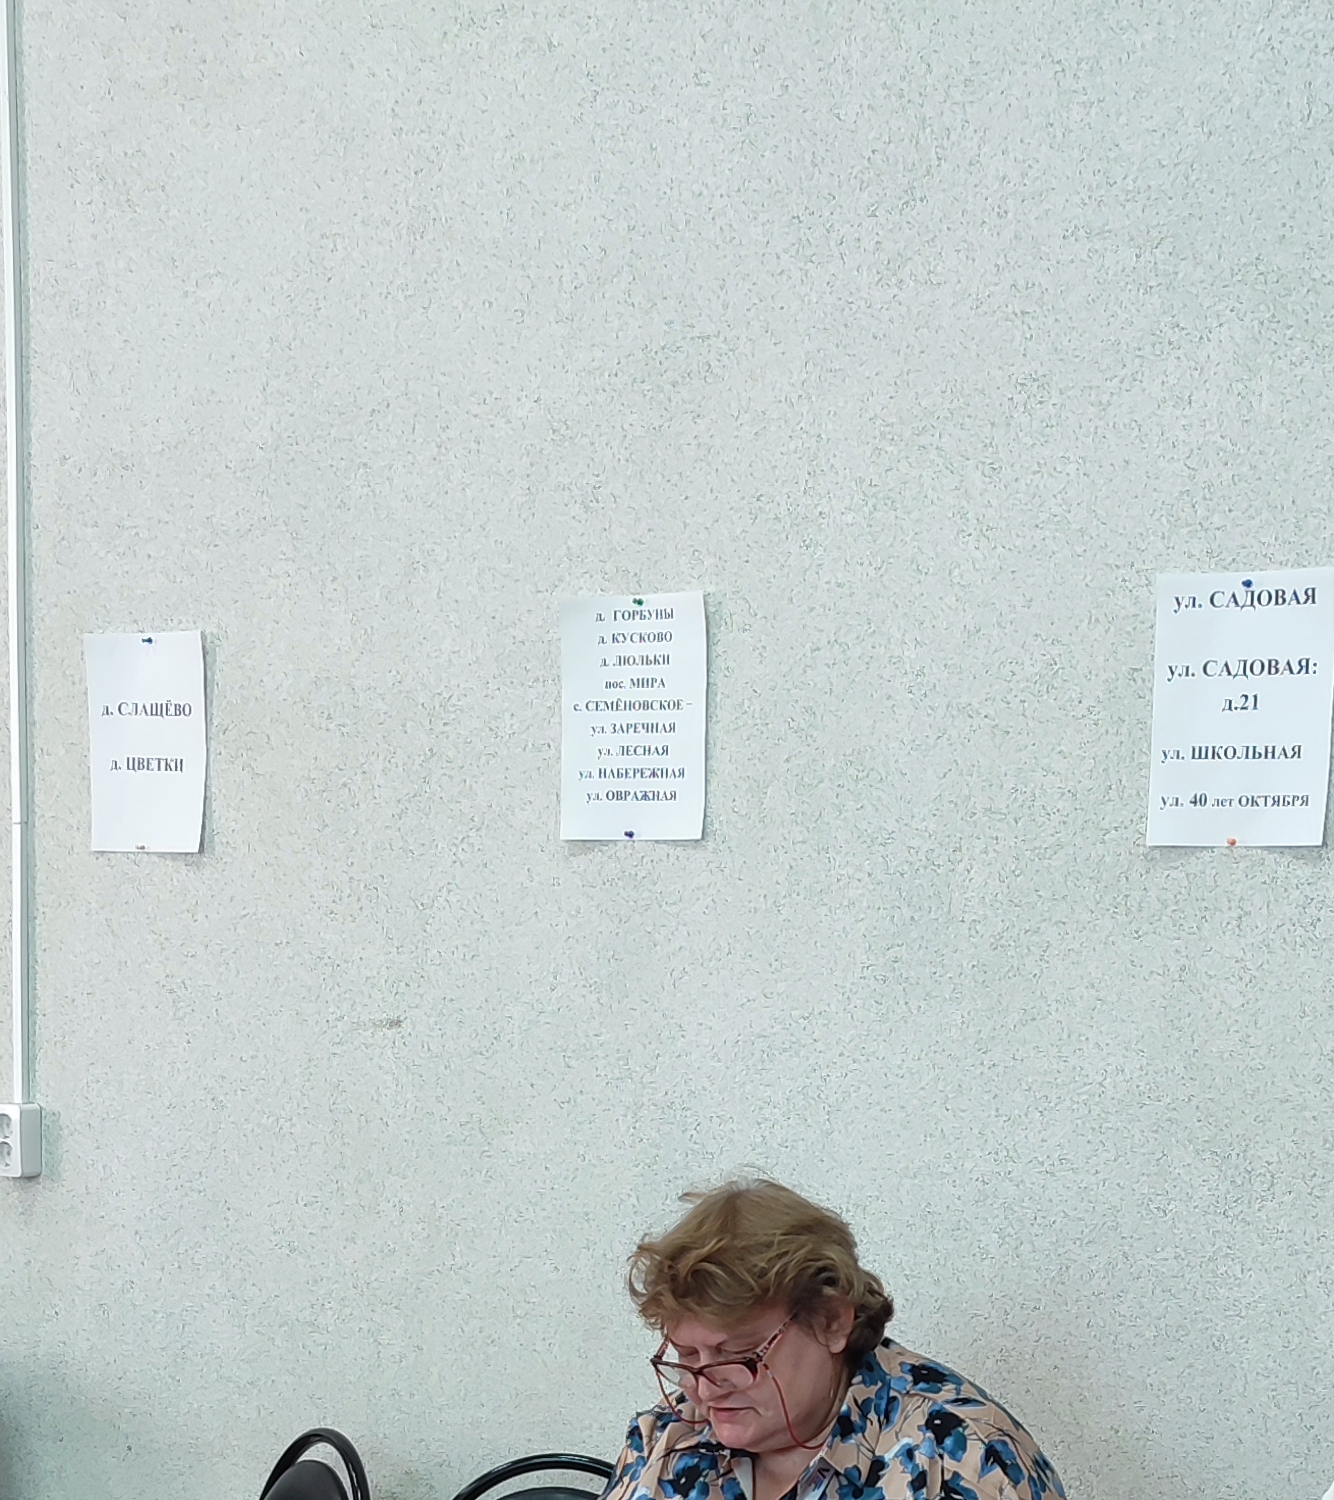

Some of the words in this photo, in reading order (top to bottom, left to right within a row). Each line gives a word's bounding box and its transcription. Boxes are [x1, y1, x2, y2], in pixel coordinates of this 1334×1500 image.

[1174, 597, 1202, 613] ул.
[1210, 587, 1316, 610] САДОВАЯ
[596, 613, 605, 622] д.
[614, 608, 673, 622] ГОРБУНЫ
[598, 636, 607, 645] д.
[612, 631, 672, 643] КУСКОВО
[613, 654, 669, 666] ЛЮЛЬКИ
[1167, 665, 1195, 682] ул.
[1203, 658, 1317, 679] САДОВАЯ:
[605, 681, 625, 689] пос.
[630, 678, 665, 688] МИРА
[102, 706, 113, 716] д.
[118, 700, 191, 718] СЛАЩЁВО
[586, 698, 683, 711] СЕМЁНОВСКОЕ
[1222, 694, 1257, 712] д.21
[591, 726, 607, 737] ул.
[611, 722, 675, 734] ЗАРЕЧНАЯ
[598, 748, 613, 760] ул.
[616, 745, 668, 756] ЛЕСНАЯ
[1161, 750, 1184, 763] ул.
[1192, 745, 1301, 760] ШКОЛЬНАЯ
[111, 760, 121, 771] д.
[127, 757, 183, 773] ЦВЕТКИ
[579, 771, 594, 780] ул.
[599, 768, 684, 779] НАБЕРЕЖНАЯ
[587, 792, 602, 805] ул.
[606, 790, 676, 801] ОВРАЖНАЯ
[1160, 796, 1183, 810] ул.
[1190, 793, 1207, 807] 40
[1212, 797, 1234, 807] лет
[1238, 795, 1309, 807] ОКТЯБРЯ
